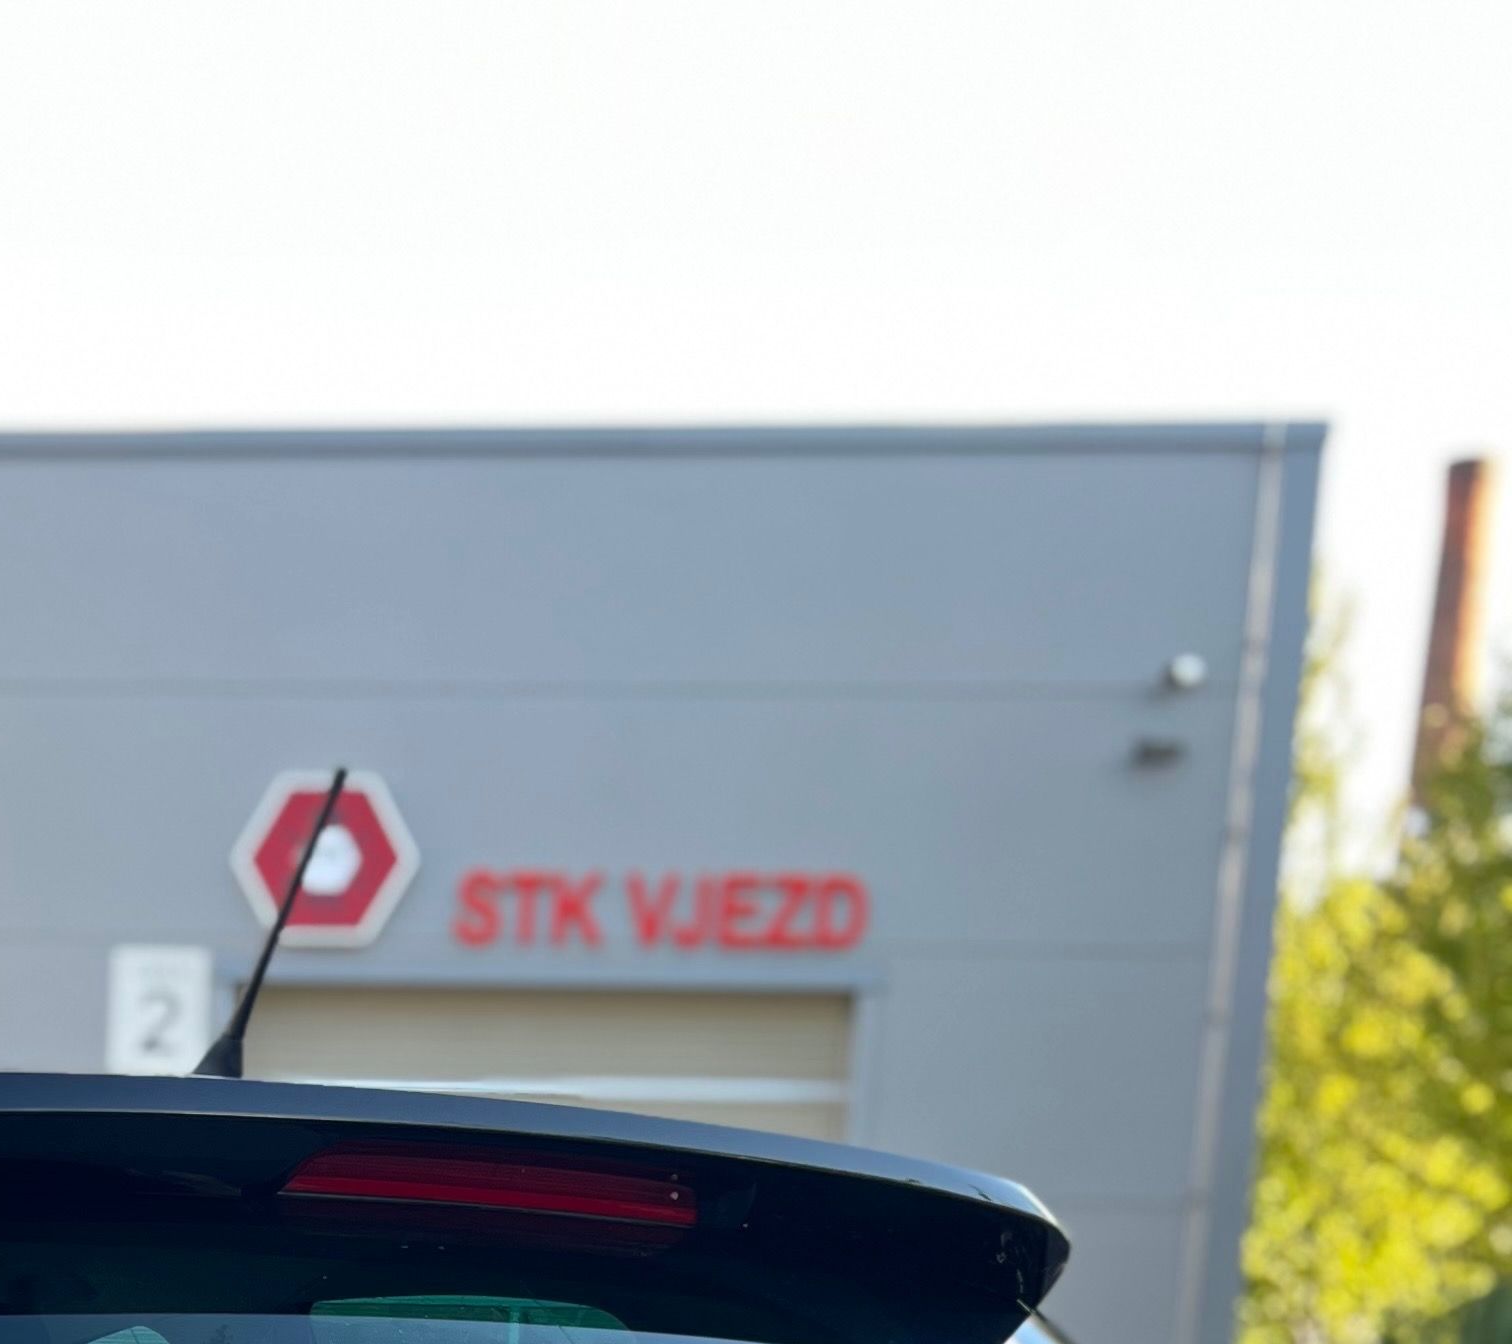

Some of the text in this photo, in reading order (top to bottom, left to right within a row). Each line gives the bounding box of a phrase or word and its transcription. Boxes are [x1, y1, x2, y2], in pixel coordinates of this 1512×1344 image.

[452, 869, 871, 951] STK VJEZD
[136, 987, 181, 1055] 2
